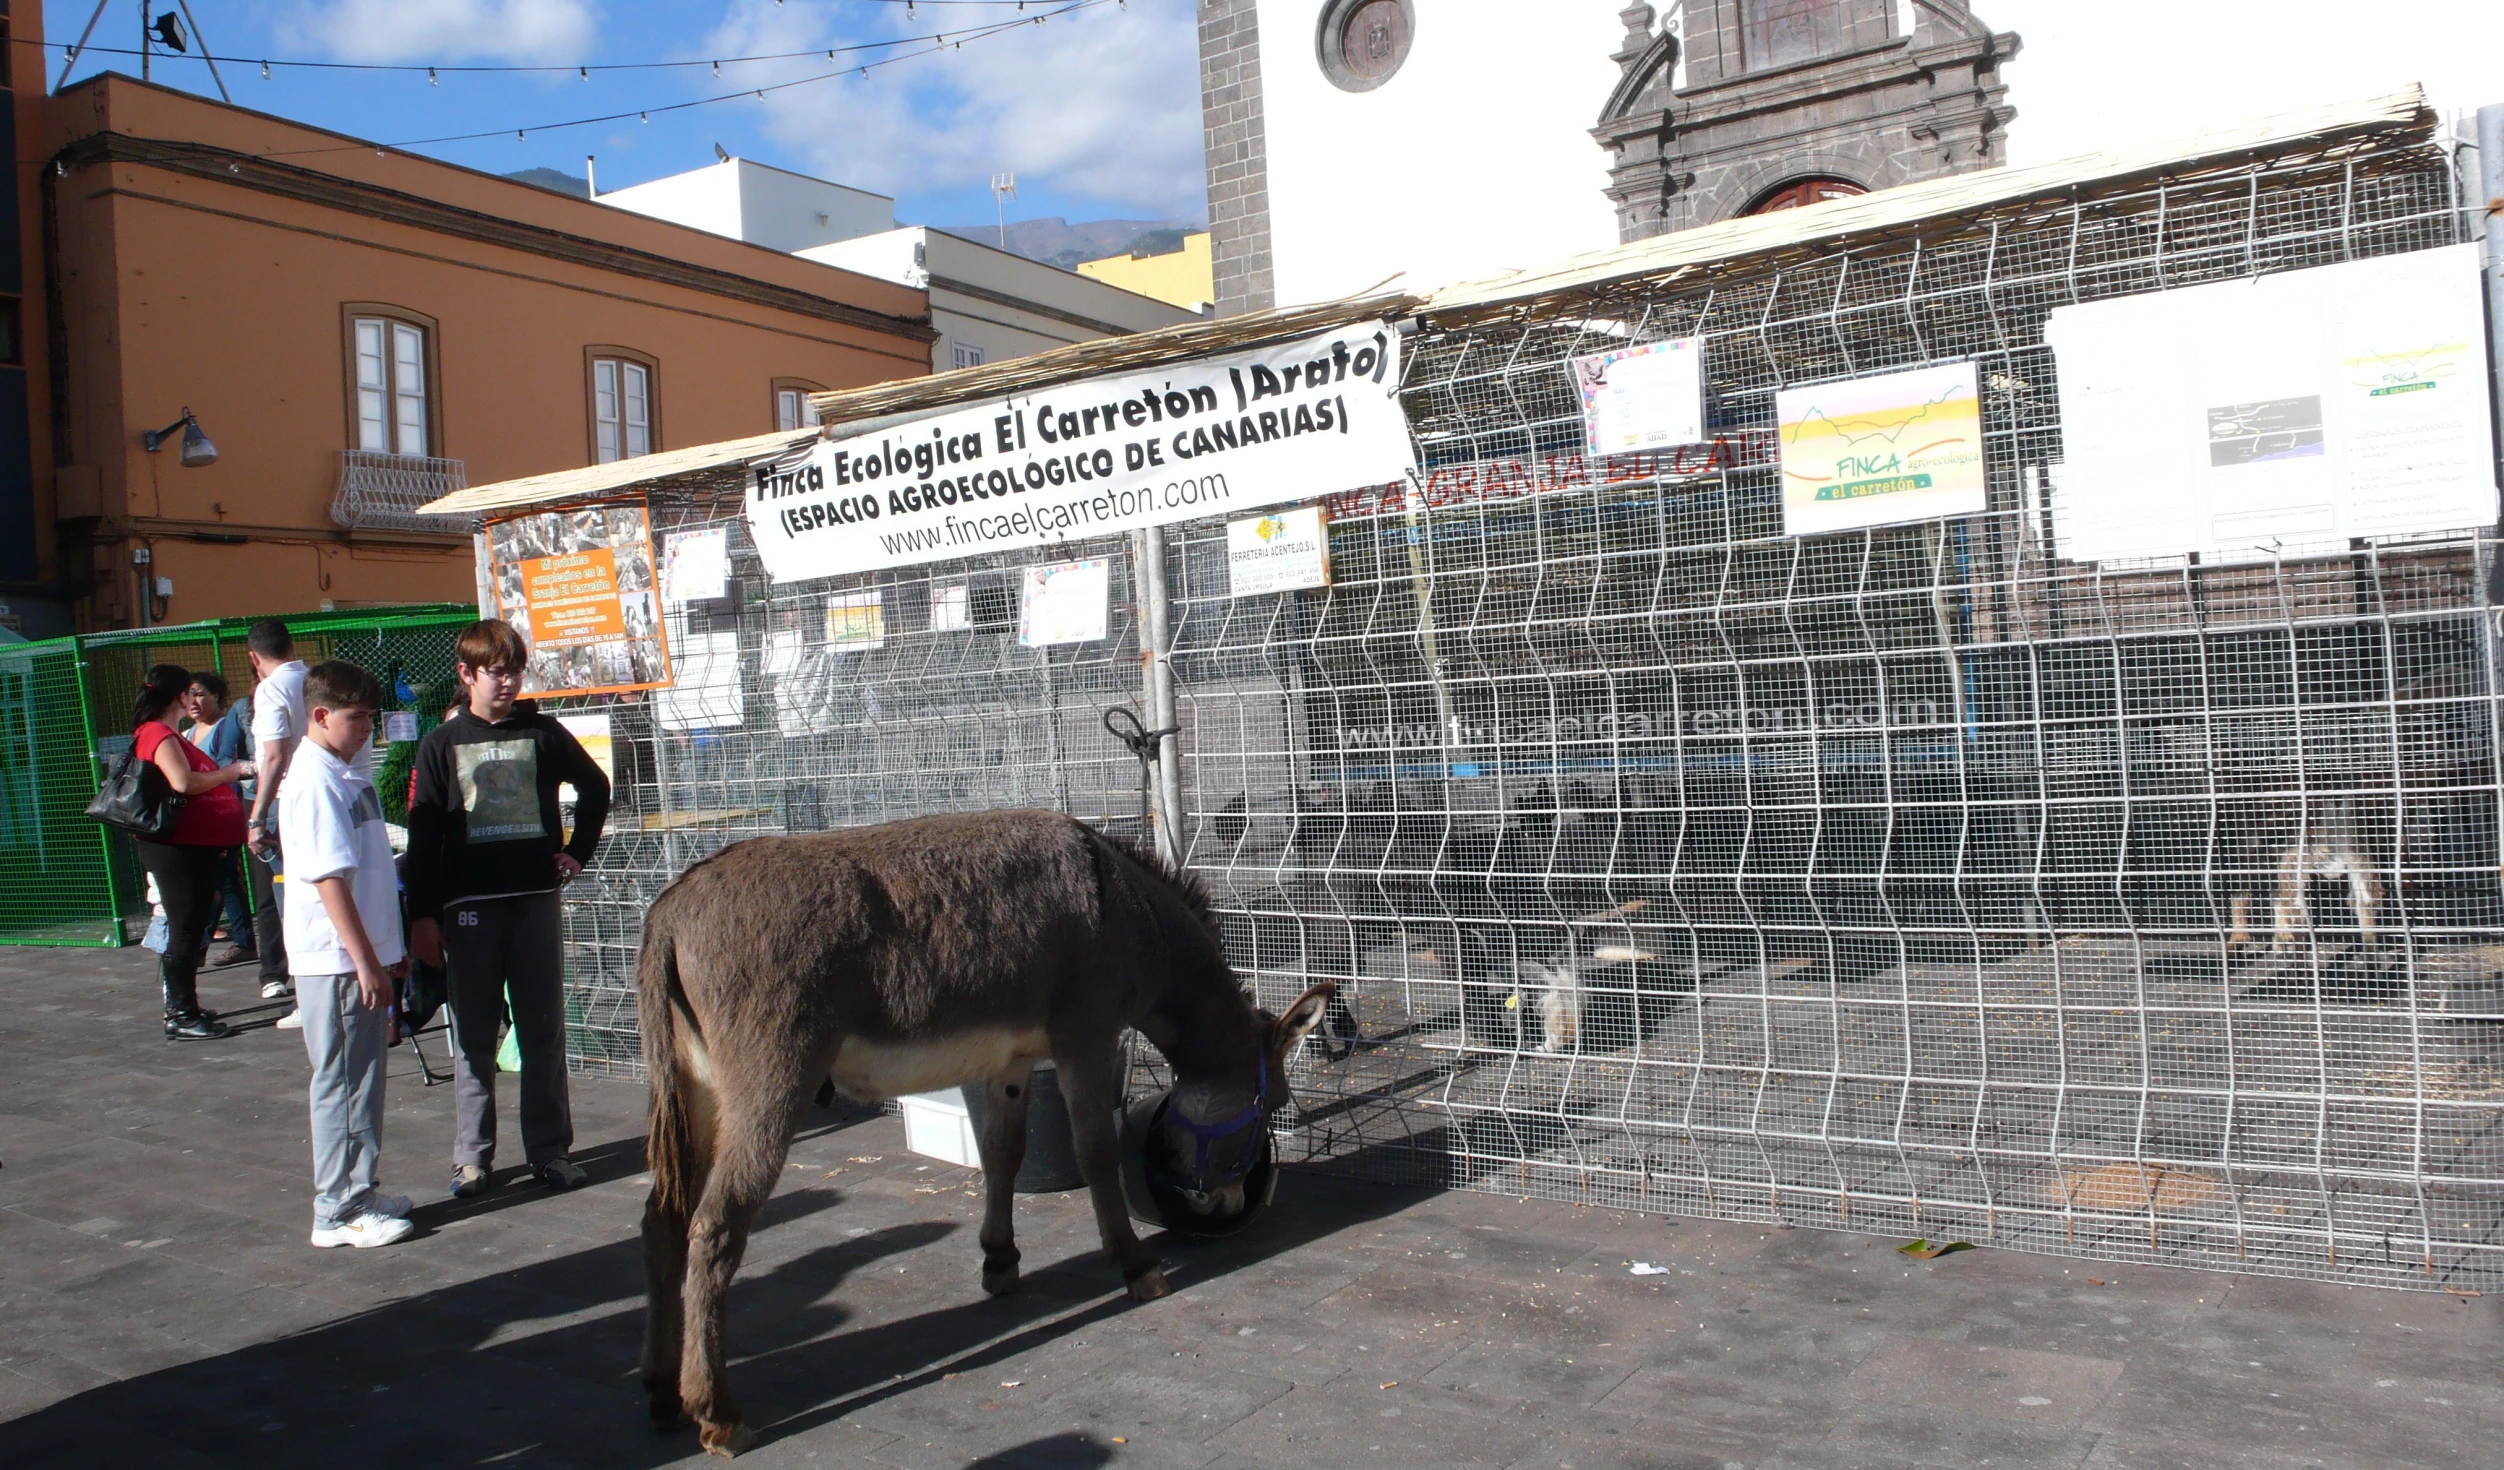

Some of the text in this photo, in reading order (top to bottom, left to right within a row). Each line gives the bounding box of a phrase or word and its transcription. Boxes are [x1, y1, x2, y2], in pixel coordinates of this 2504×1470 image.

[2382, 371, 2419, 384] FINCA
[756, 463, 824, 501] Finca
[834, 427, 983, 486] Ecológica
[994, 410, 1026, 454] El
[1037, 381, 1218, 444] Carretón
[1647, 433, 1668, 442] ABAD
[780, 394, 1348, 539] (ESPACIO AGROECOLÓGICO DE CANARIAS)
[1836, 450, 1980, 478] FINCA agro-ecológica
[1832, 477, 1917, 498] el carretón
[880, 473, 1229, 555] www.fincaelcarreton.com
[1231, 548, 1269, 562] FERRETERIA
[553, 555, 590, 571] próximo
[583, 568, 595, 578] en
[596, 565, 606, 577] la
[560, 583, 569, 595] El
[570, 579, 610, 594] Carretón
[572, 636, 583, 645] LOS
[469, 824, 514, 837] REVENGE
[521, 823, 541, 833] SITH
[458, 911, 479, 926] 86
